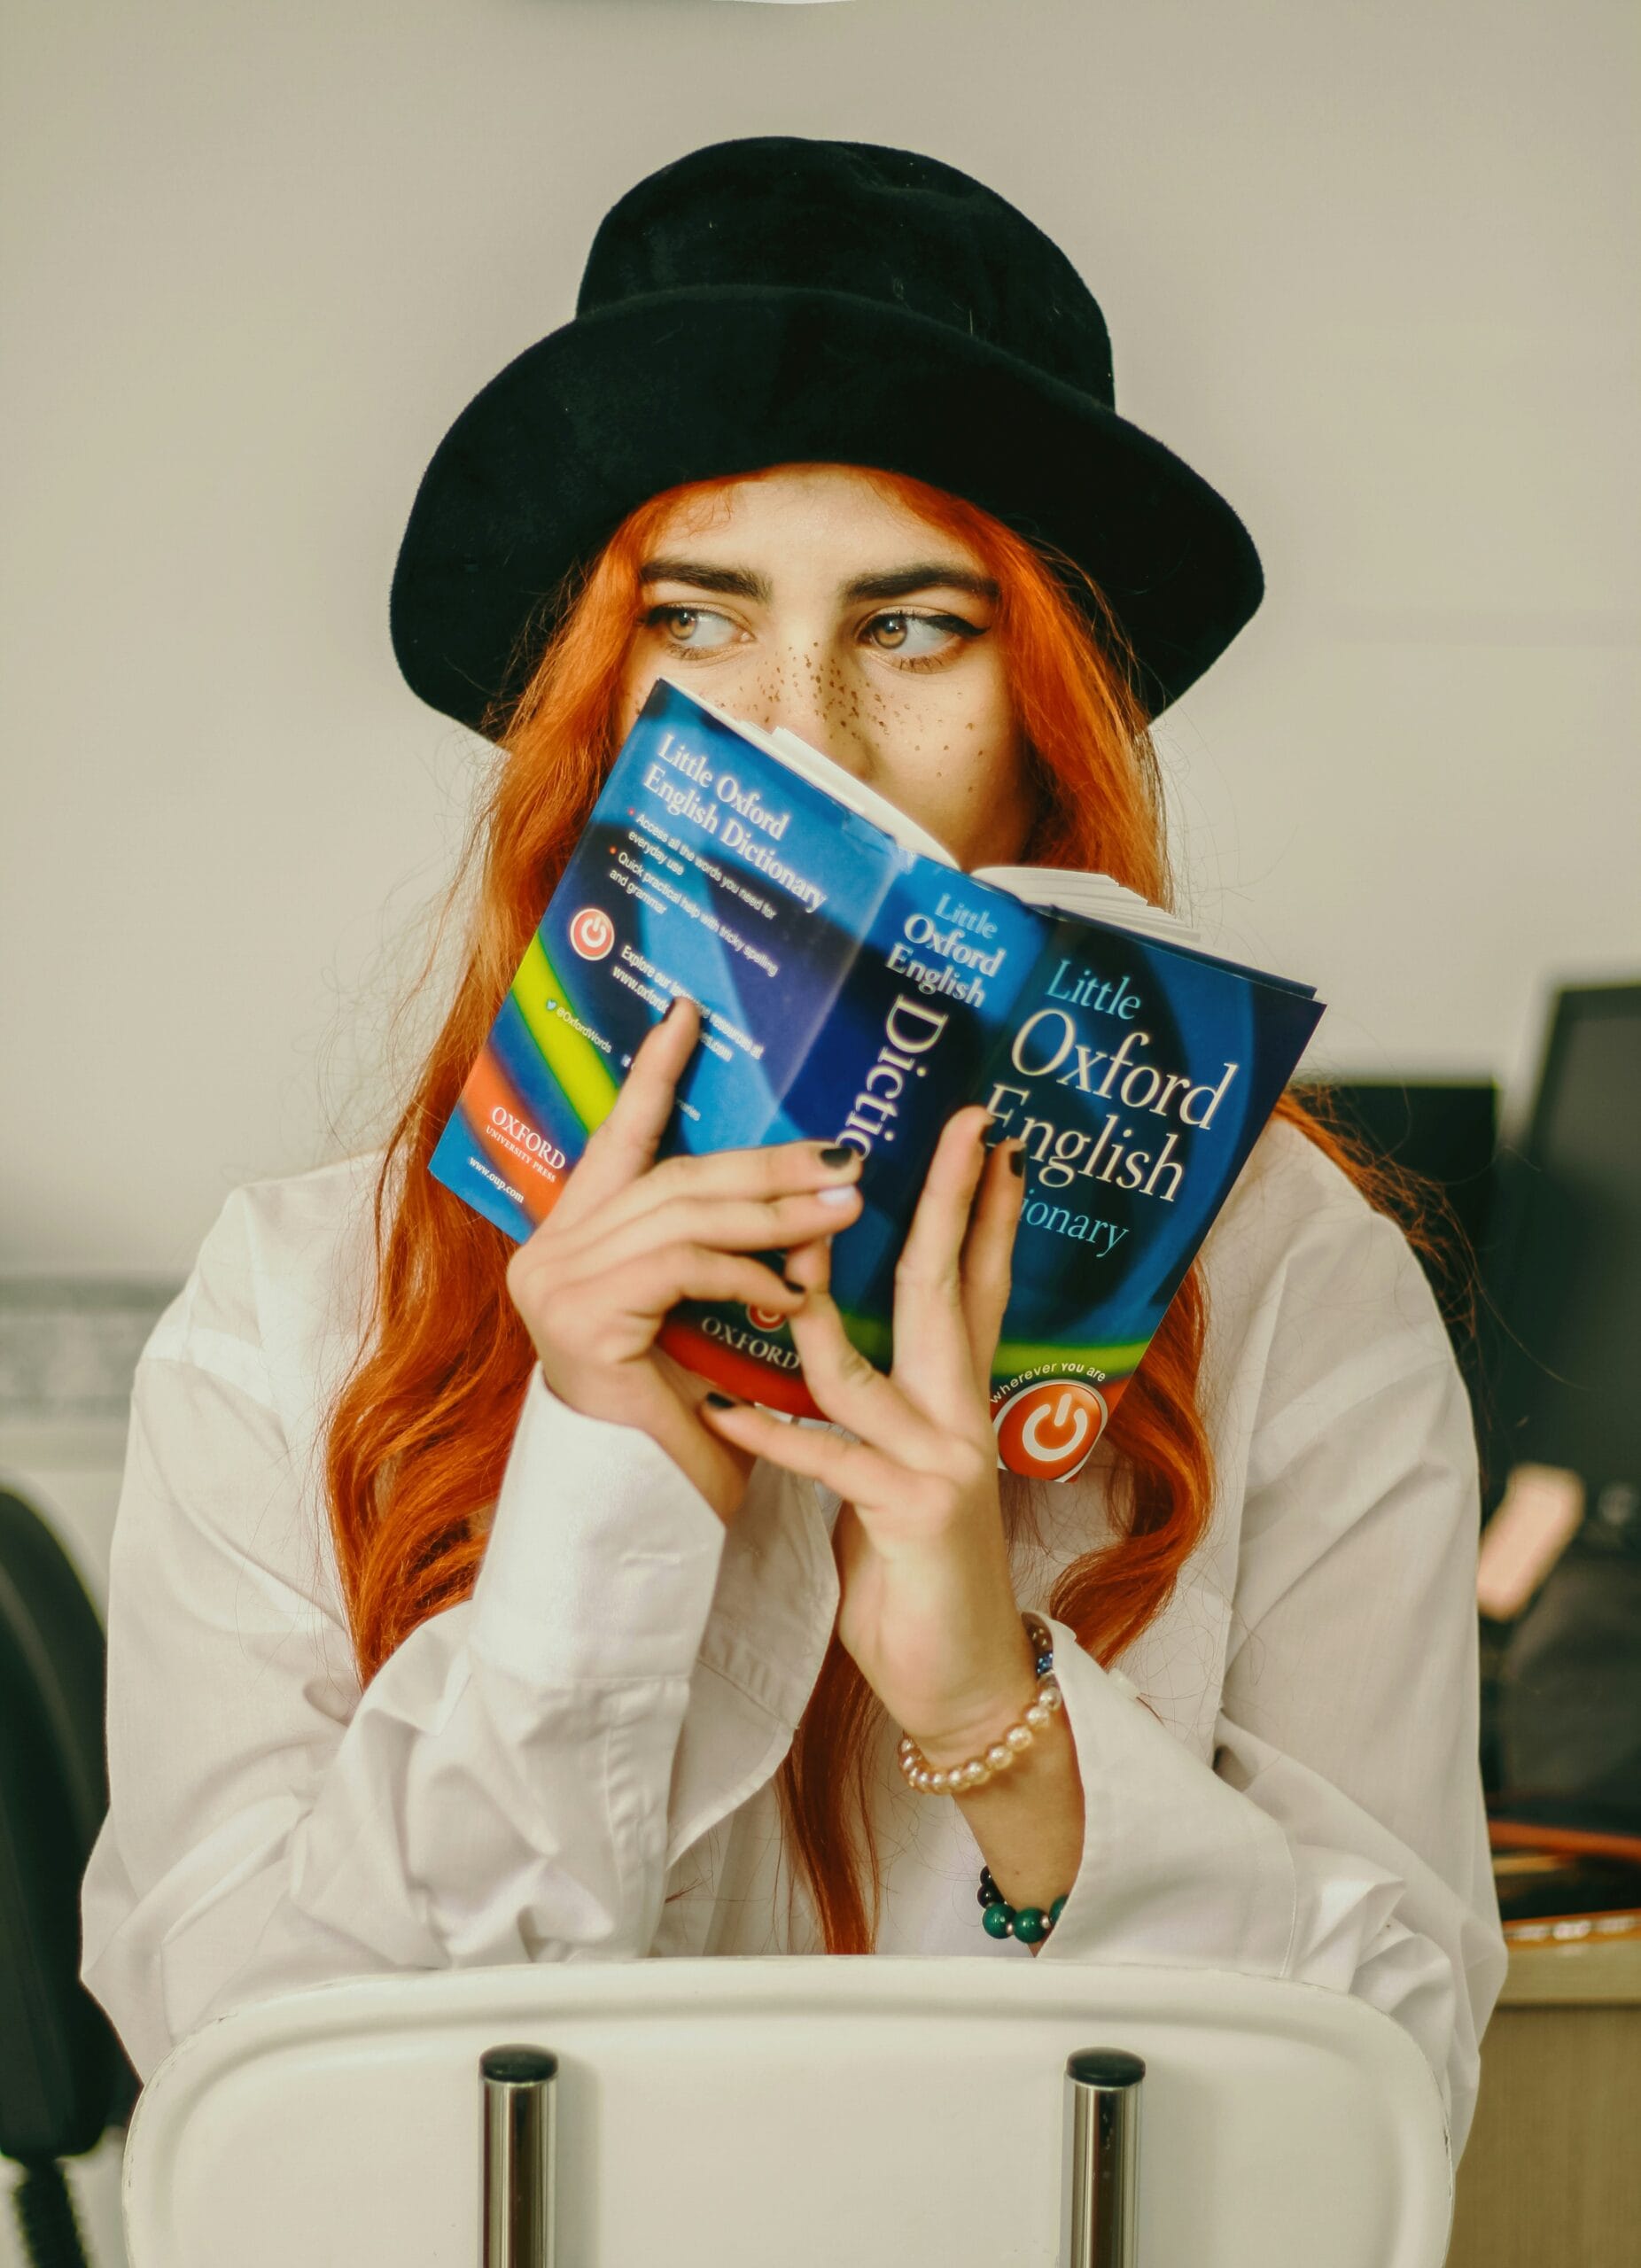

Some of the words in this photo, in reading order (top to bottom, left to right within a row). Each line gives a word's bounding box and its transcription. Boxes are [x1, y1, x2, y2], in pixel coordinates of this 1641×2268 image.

[657, 734, 712, 788] Little
[717, 776, 789, 841] Oxford
[628, 831, 667, 865] everyday
[666, 858, 684, 875] use
[636, 814, 668, 842] Access
[668, 837, 681, 851] all
[679, 844, 695, 862] the
[695, 856, 722, 882] words
[720, 877, 740, 894] you
[738, 888, 764, 911] need
[762, 901, 777, 920] for
[643, 764, 719, 834] English
[720, 818, 828, 914] Dictionary
[610, 869, 628, 886] and
[626, 882, 667, 914] grammar
[618, 852, 644, 877] Quick
[642, 871, 682, 906] practical
[680, 895, 700, 919] help
[699, 911, 720, 932] with
[719, 924, 745, 951] tricky
[743, 944, 779, 977] spelling
[935, 893, 999, 939] Little
[886, 942, 986, 1008] English
[904, 913, 1007, 977] Oxford
[621, 945, 656, 978] Explore
[654, 972, 672, 989] our
[709, 1012, 753, 1052] resources
[750, 1045, 764, 1060] at
[1046, 959, 1142, 1021] Little
[556, 1006, 612, 1053] @OxfordWords
[836, 993, 949, 1161] Dictio
[1011, 1008, 1239, 1130] Oxford
[486, 1125, 533, 1164] UNIVERSITY
[533, 1161, 556, 1183] PRESS
[492, 1107, 566, 1169] OXFORD
[984, 1083, 1186, 1202] English
[469, 1157, 525, 1203] www.oup.com
[1018, 1188, 1130, 1257] ionary
[702, 1317, 800, 1370] OXFORD
[991, 1363, 1058, 1404] wherever
[1086, 1366, 1106, 1382] are
